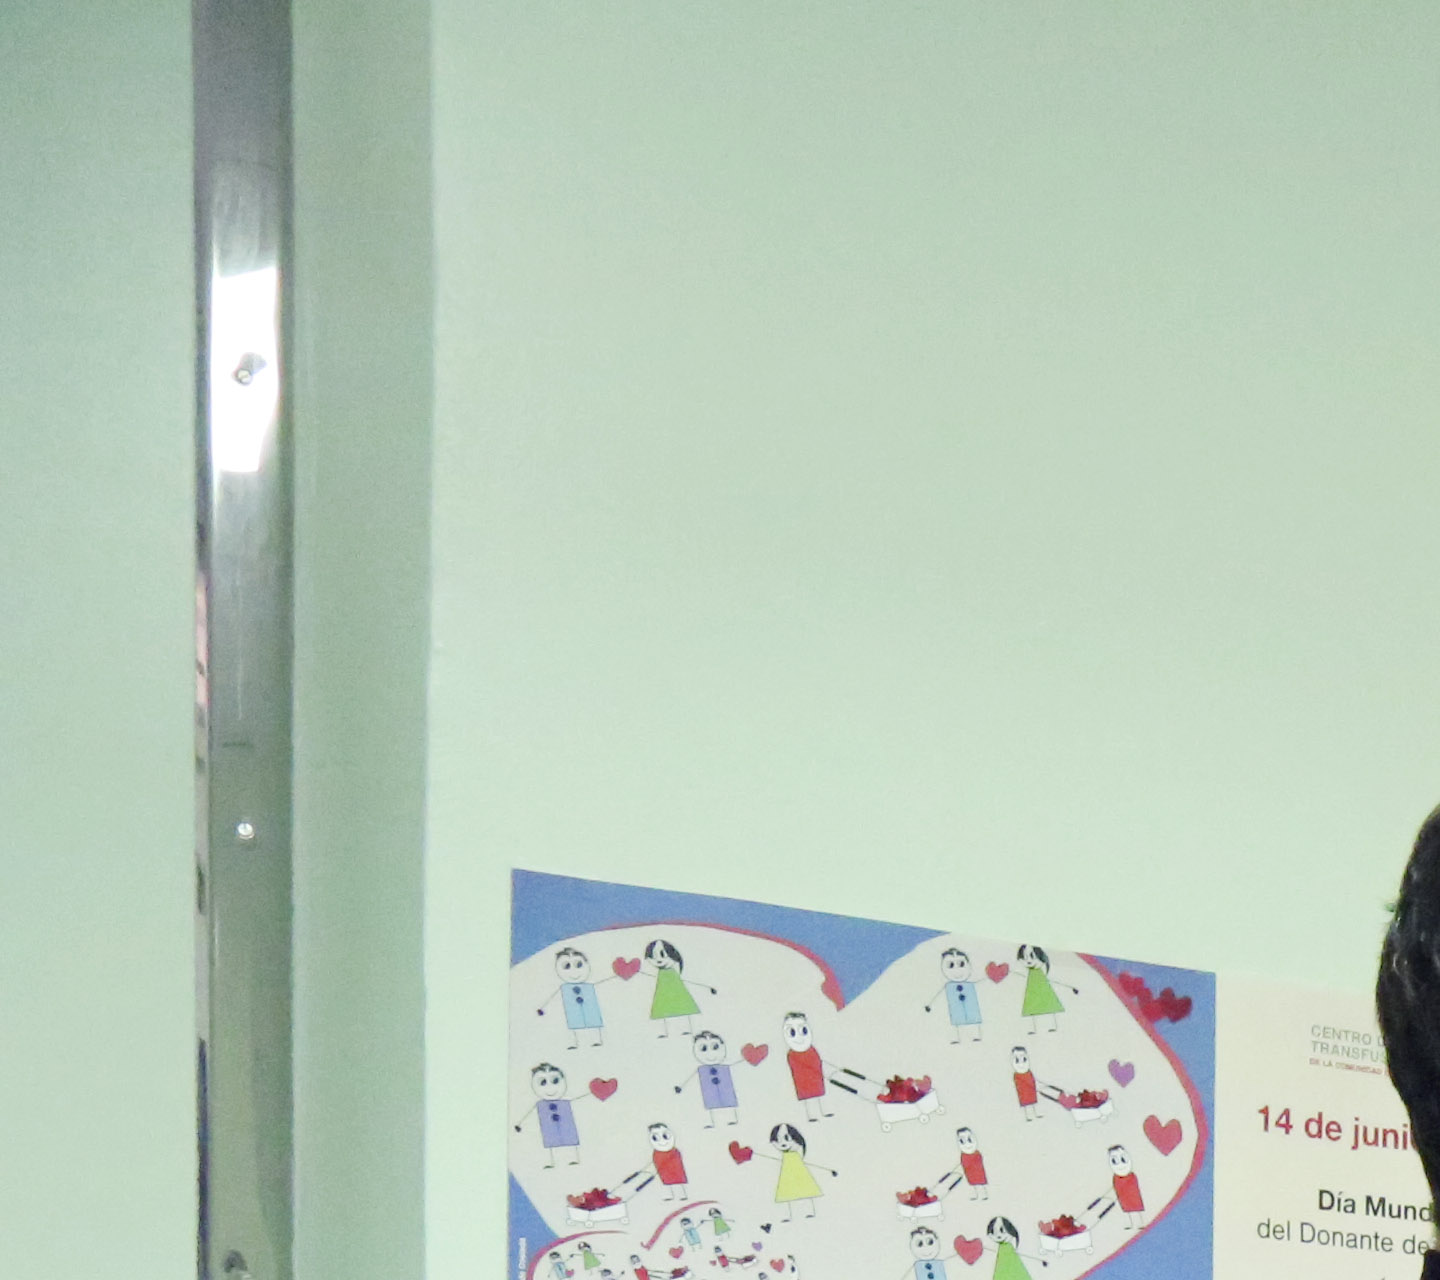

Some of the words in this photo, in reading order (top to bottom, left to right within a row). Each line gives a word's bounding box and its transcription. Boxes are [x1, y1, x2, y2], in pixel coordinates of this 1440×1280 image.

[1311, 1024, 1372, 1046] CENTRO
[1258, 1105, 1294, 1135] 14
[1304, 1112, 1342, 1142] de
[1318, 1189, 1356, 1214] Día
[1366, 1195, 1434, 1222] Mund
[1257, 1219, 1291, 1241] del
[1300, 1222, 1394, 1253] Donante
